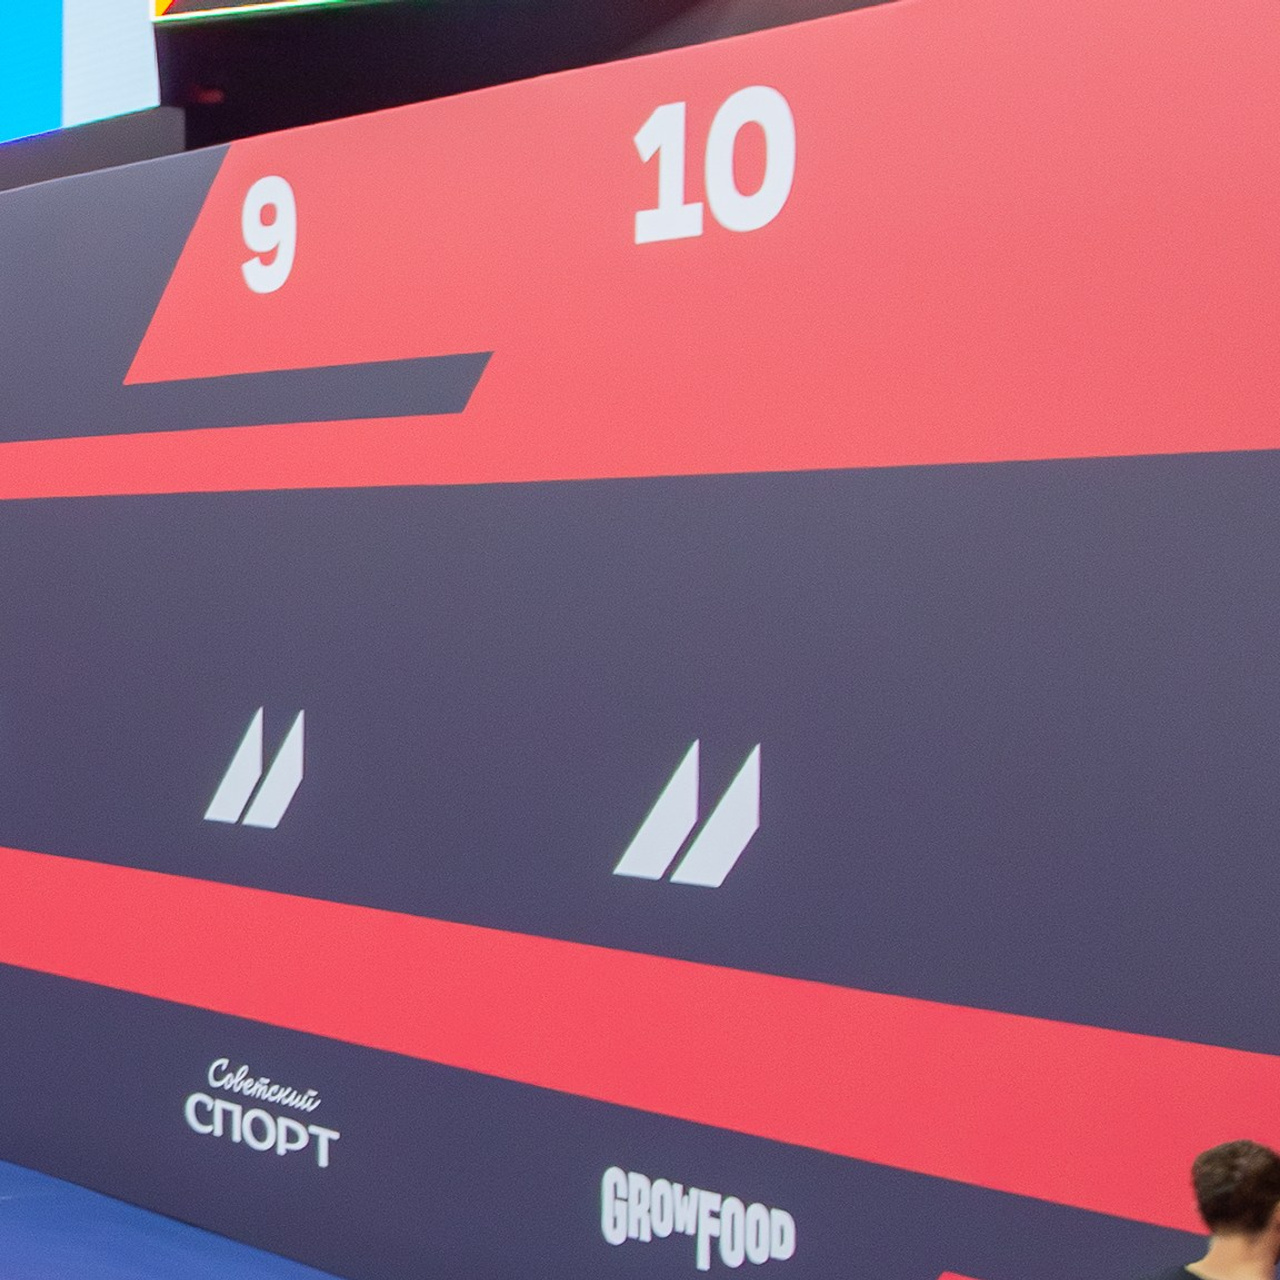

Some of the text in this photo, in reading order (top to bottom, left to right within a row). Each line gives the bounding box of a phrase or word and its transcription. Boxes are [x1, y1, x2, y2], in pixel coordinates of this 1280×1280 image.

[633, 85, 796, 245] 10
[241, 175, 297, 294] 9
[185, 1093, 341, 1168] СПОРТ
[208, 1058, 322, 1113] Советский
[601, 1166, 796, 1271] GROWFOOD
